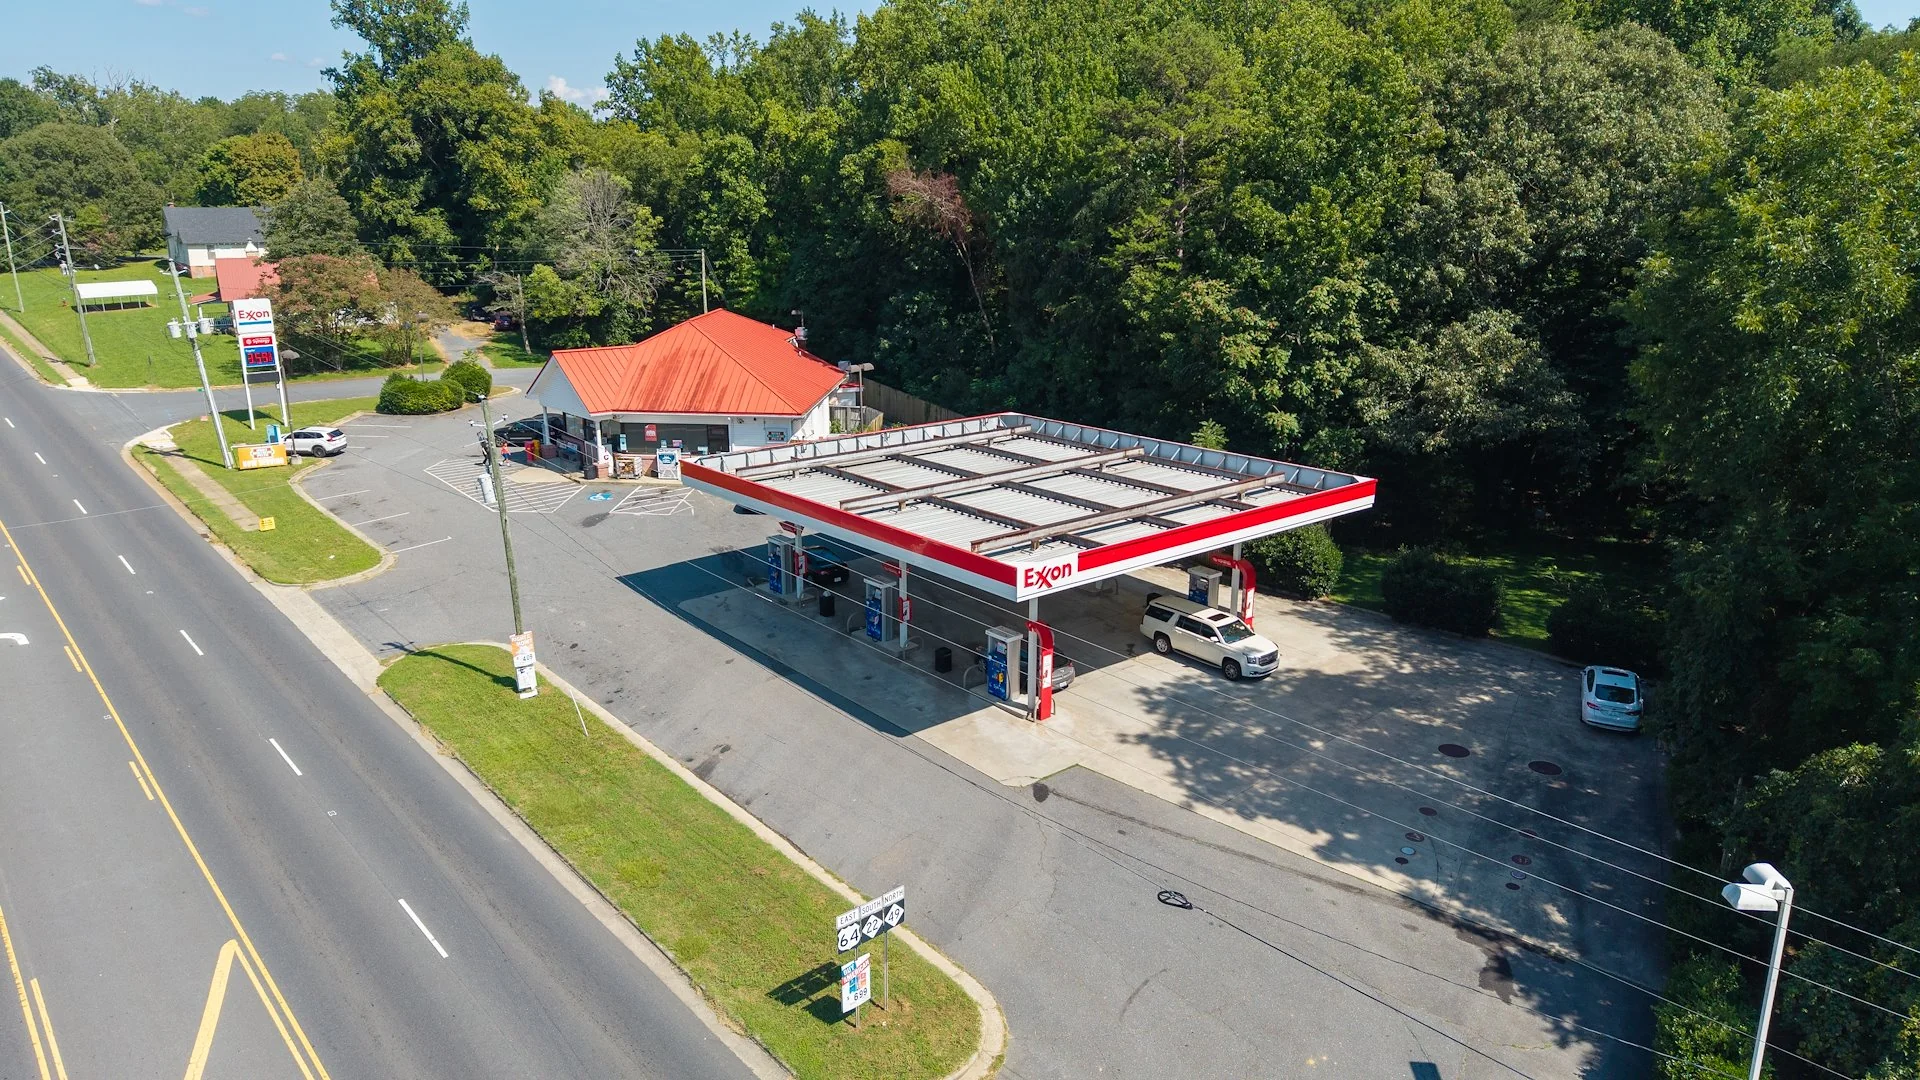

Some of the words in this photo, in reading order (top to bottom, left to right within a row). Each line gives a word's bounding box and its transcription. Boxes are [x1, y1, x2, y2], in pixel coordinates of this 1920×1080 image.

[238, 309, 270, 321] Exxon
[1024, 563, 1072, 589] Exxon
[884, 890, 903, 903] NORTH
[862, 901, 881, 915] SOUTH
[888, 908, 900, 921] 49
[840, 911, 857, 925] EAST
[866, 919, 878, 933] 22
[840, 928, 859, 947] 64
[854, 987, 868, 1001] 699
